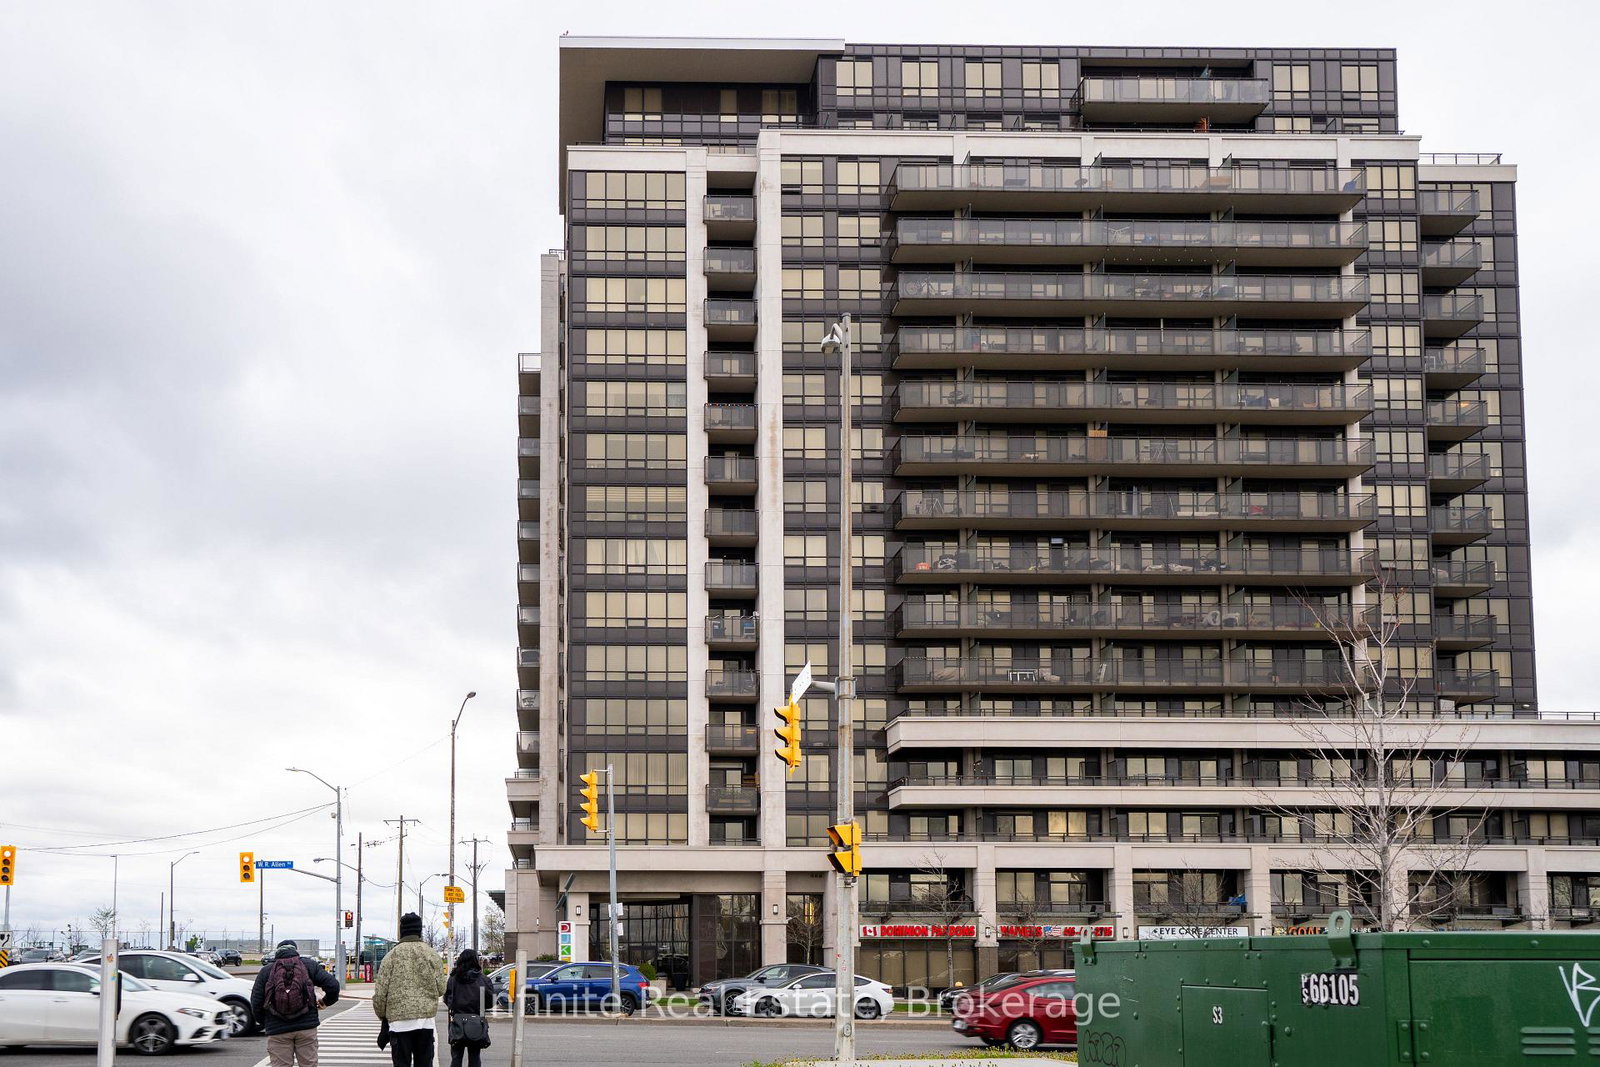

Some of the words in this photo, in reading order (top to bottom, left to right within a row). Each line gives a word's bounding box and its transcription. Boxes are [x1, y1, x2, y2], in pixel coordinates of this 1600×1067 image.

[880, 926, 928, 936] DOMINION
[1310, 974, 1359, 1005] 66105
[1212, 1006, 1222, 1024] S3
